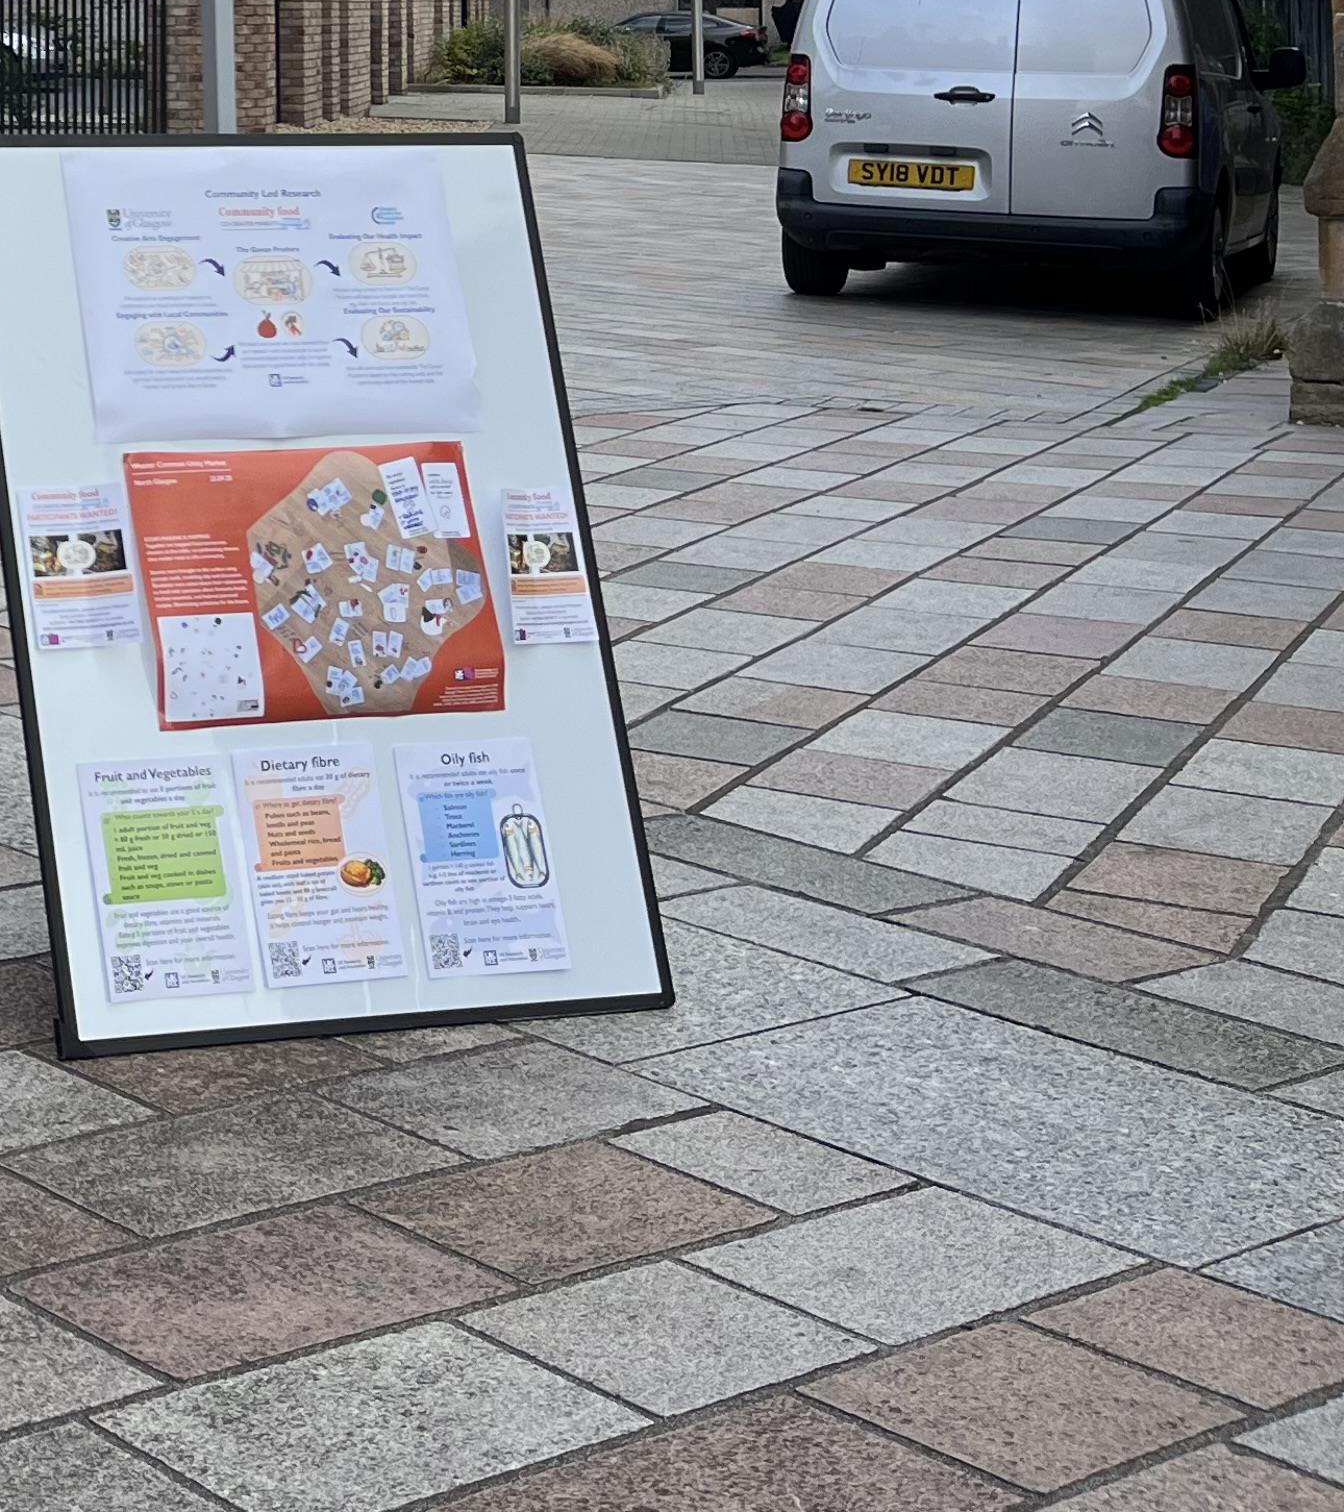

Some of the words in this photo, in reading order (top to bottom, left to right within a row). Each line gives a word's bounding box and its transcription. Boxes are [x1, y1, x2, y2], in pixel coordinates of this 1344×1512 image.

[862, 162, 909, 183] SY18
[917, 165, 960, 185] VDT
[204, 190, 259, 200] Community
[281, 189, 321, 198] Research
[218, 206, 275, 218] Community
[260, 758, 308, 772] Dietary
[311, 756, 341, 769] fibre
[440, 753, 465, 767] Oily
[468, 751, 490, 764] fish
[95, 771, 123, 783] Fruit
[126, 769, 147, 781] and
[147, 766, 212, 782] Vegetables
